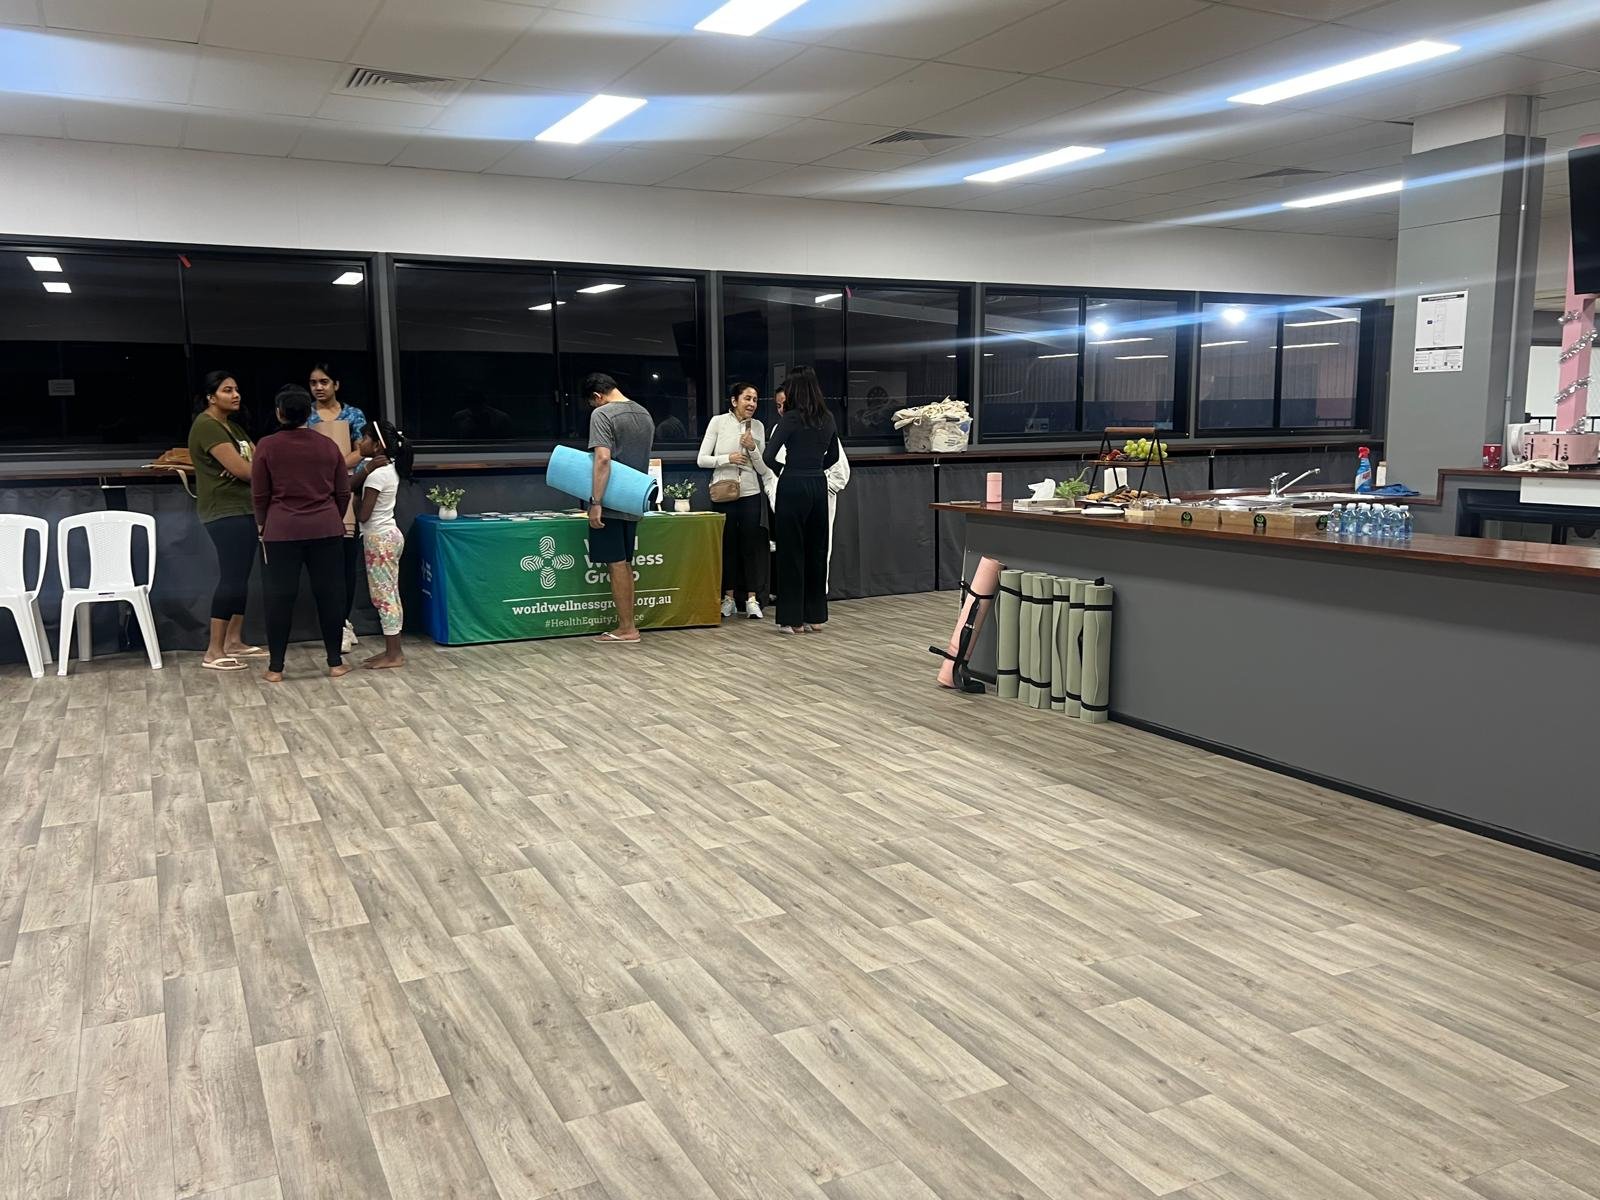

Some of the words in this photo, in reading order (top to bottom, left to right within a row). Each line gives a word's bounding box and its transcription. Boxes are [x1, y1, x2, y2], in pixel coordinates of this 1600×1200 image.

[584, 553, 664, 568] Wess
[584, 569, 640, 584] Grp
[512, 595, 672, 615] worldwellnessgr.org.au
[545, 614, 644, 627] #HealthEquityJce
